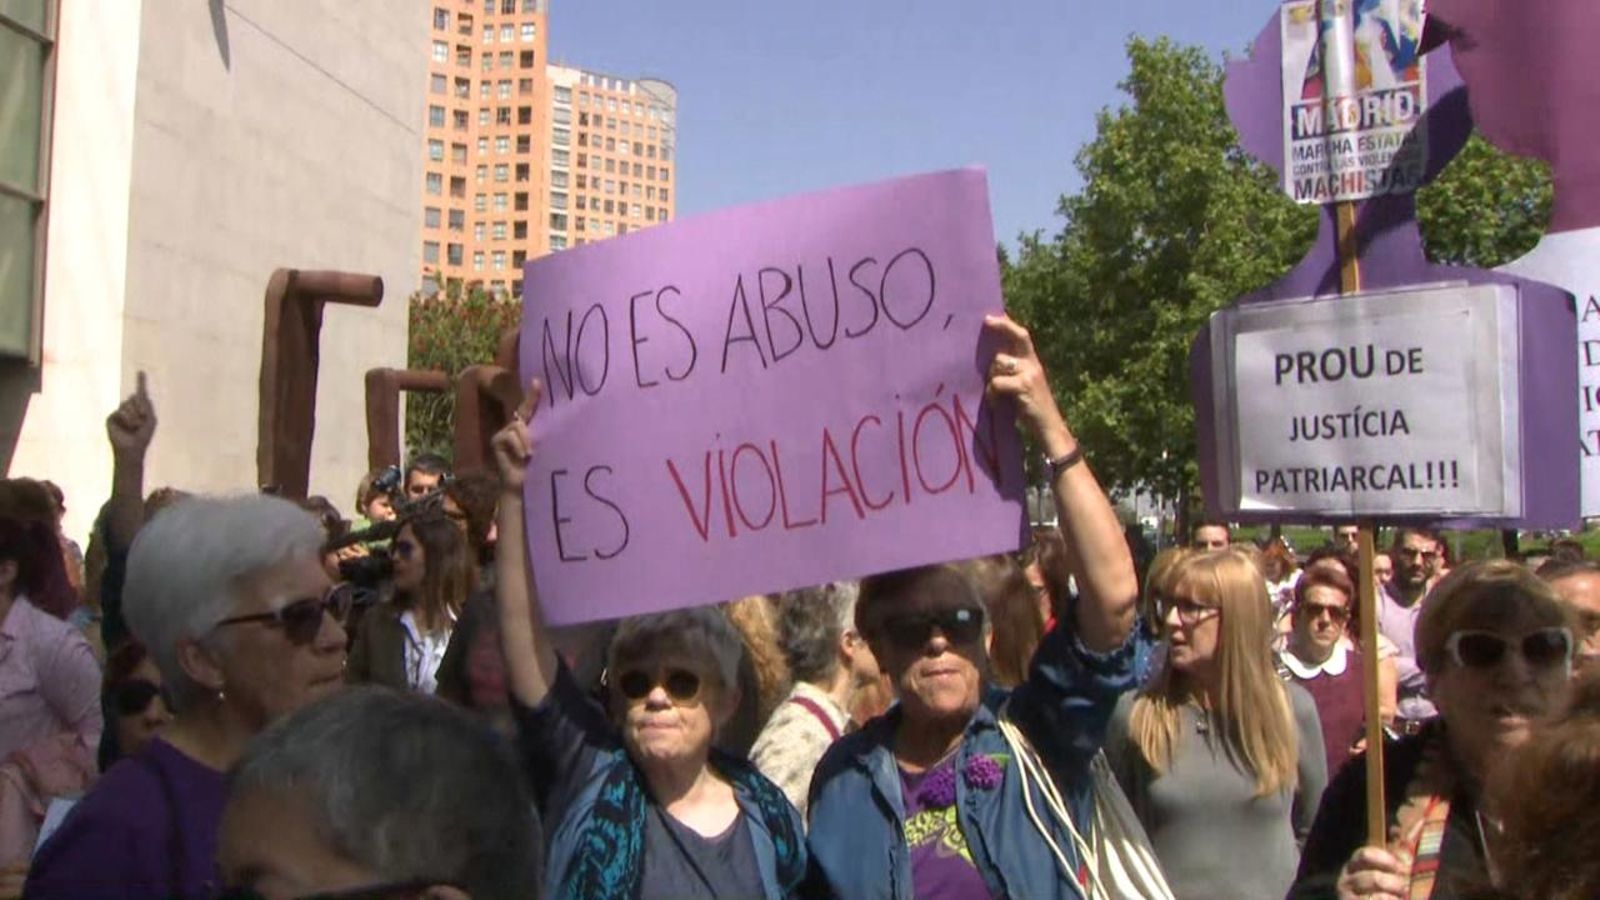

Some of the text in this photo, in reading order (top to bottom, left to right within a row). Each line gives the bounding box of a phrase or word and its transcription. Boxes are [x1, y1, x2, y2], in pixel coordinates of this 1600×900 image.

[1297, 91, 1414, 137] MADRID
[541, 247, 954, 407] NO ES ABUSO,
[1274, 344, 1424, 386] PROU DE
[1289, 405, 1410, 441] JUSTÍCIA
[1255, 460, 1460, 495] PATRIARCAL!!!
[550, 465, 630, 562] ES
